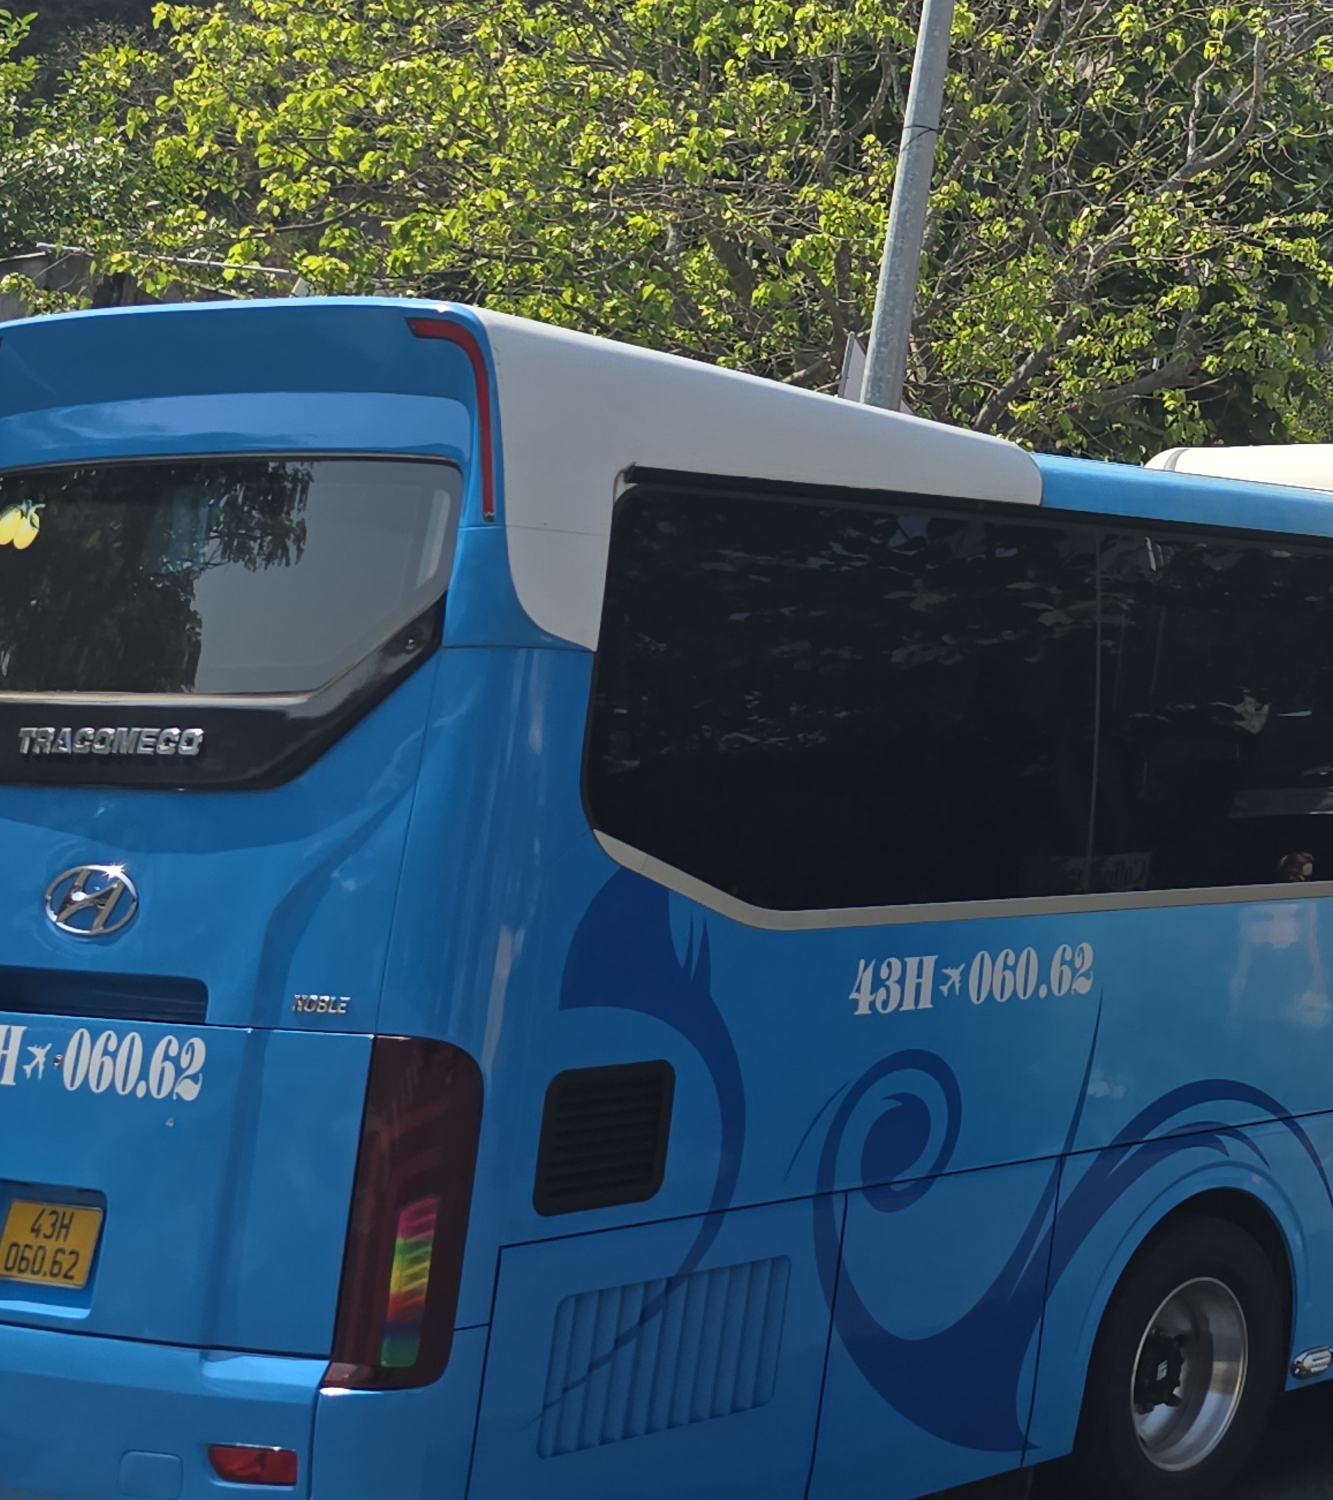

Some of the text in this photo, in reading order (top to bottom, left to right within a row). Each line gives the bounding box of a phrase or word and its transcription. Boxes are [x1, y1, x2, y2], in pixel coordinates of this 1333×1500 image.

[19, 727, 204, 756] TRACOMECO
[849, 942, 1094, 1015] 43H 060.62
[292, 994, 350, 1014] NOBLE
[63, 1028, 206, 1101] 060.62
[30, 1208, 74, 1242] 43H
[4, 1242, 80, 1280] 060.62
